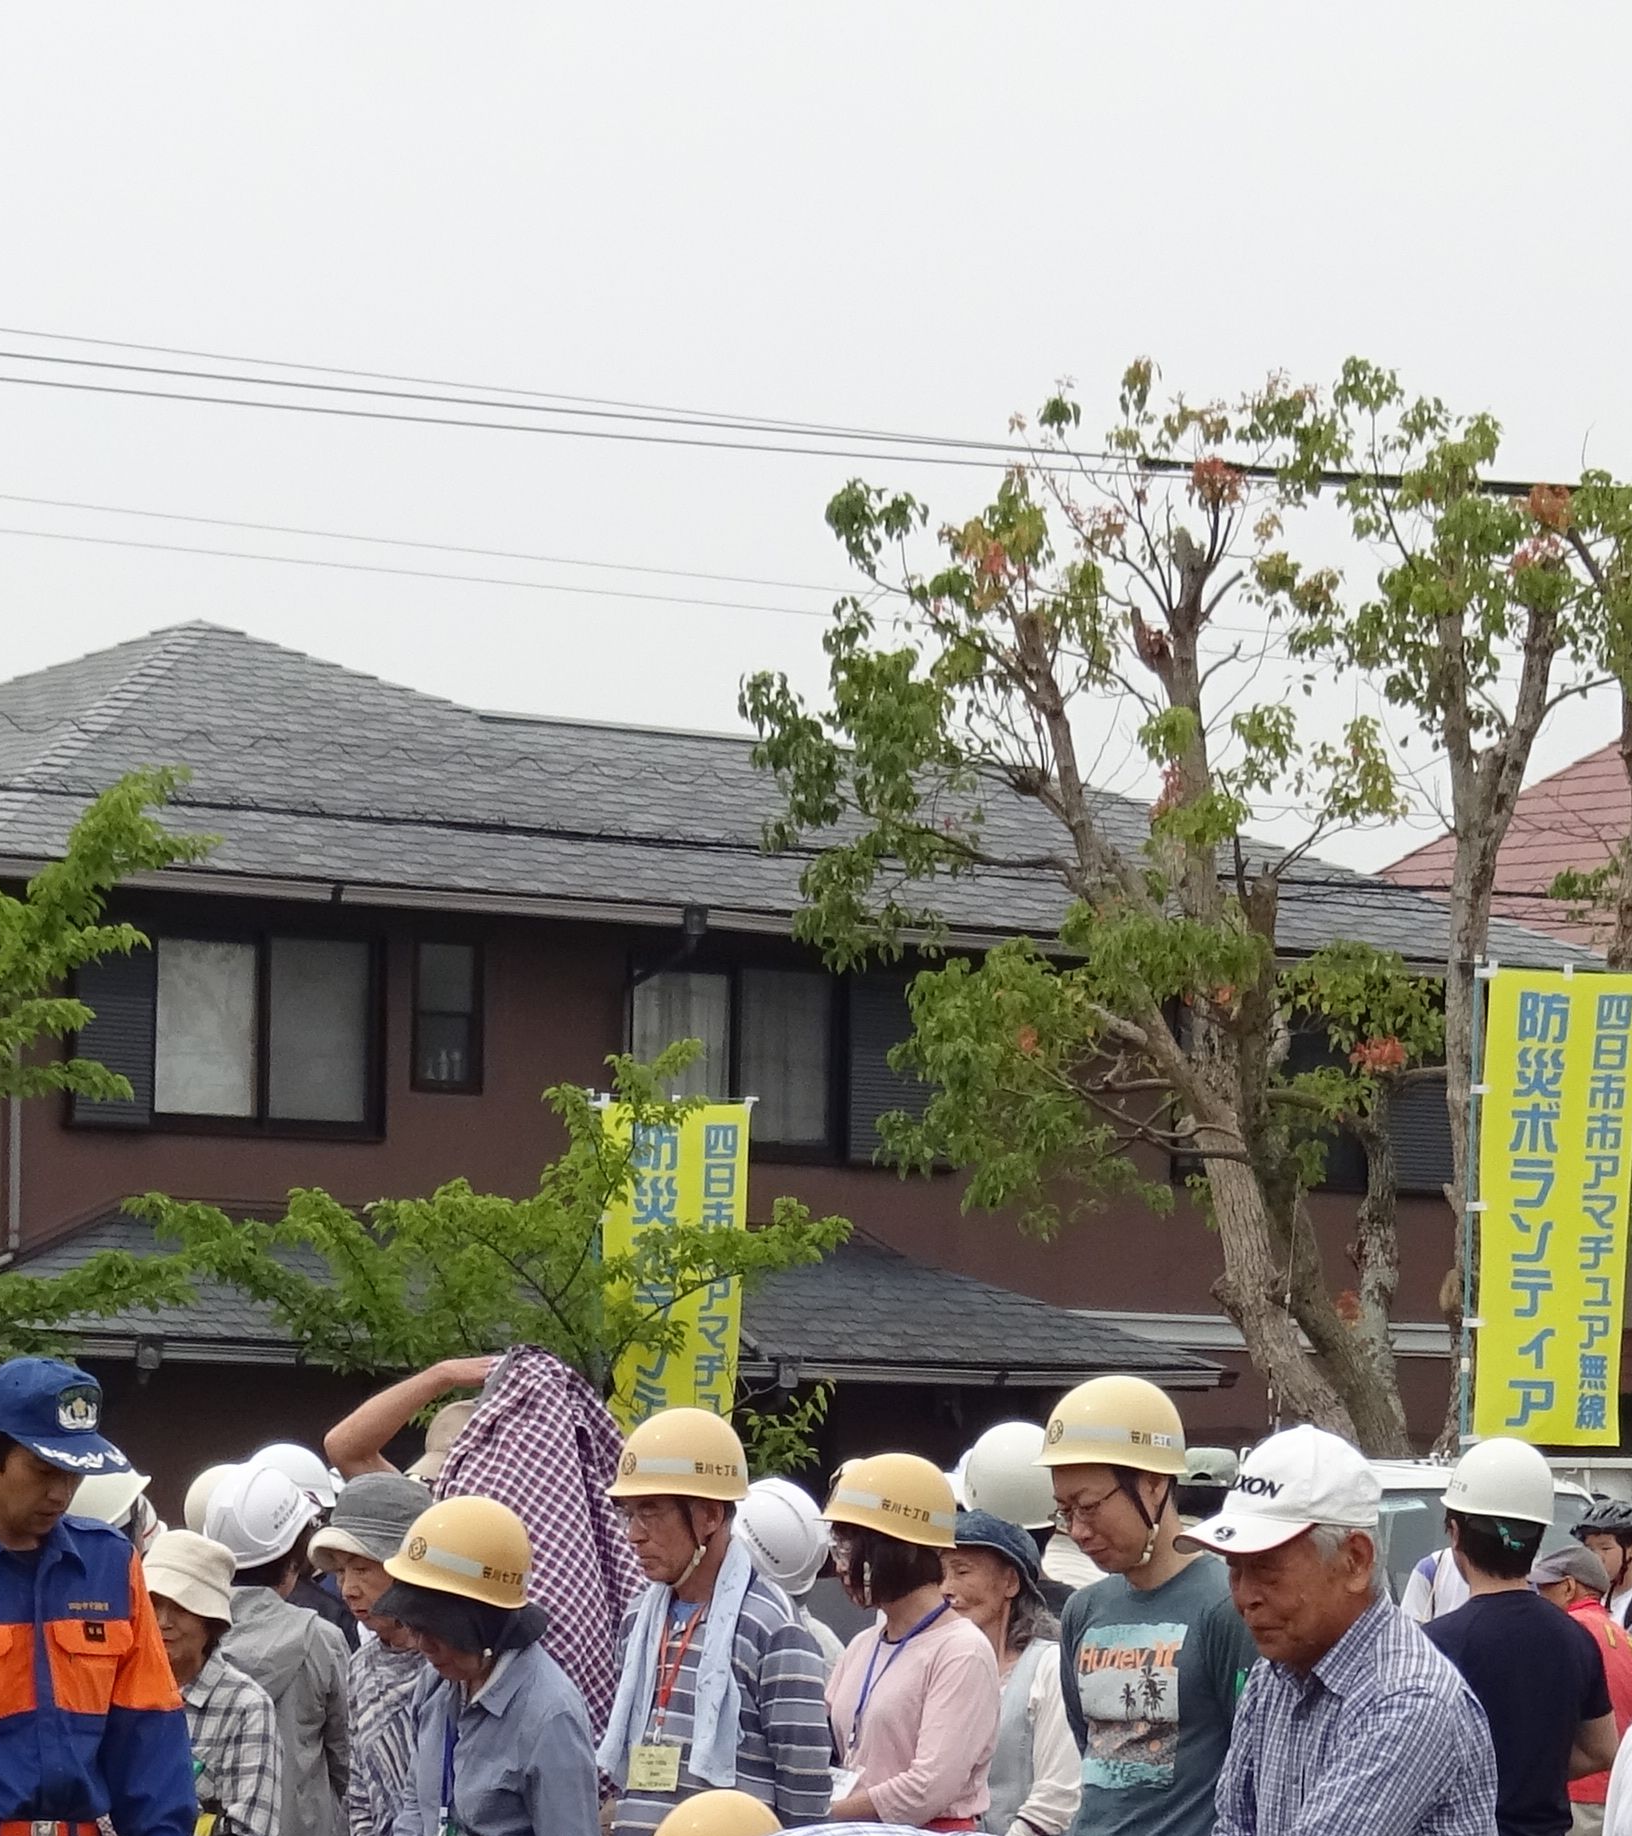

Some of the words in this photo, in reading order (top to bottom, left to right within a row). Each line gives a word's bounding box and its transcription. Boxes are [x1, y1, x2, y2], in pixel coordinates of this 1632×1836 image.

[1505, 991, 1570, 1427] 防災ボランティア
